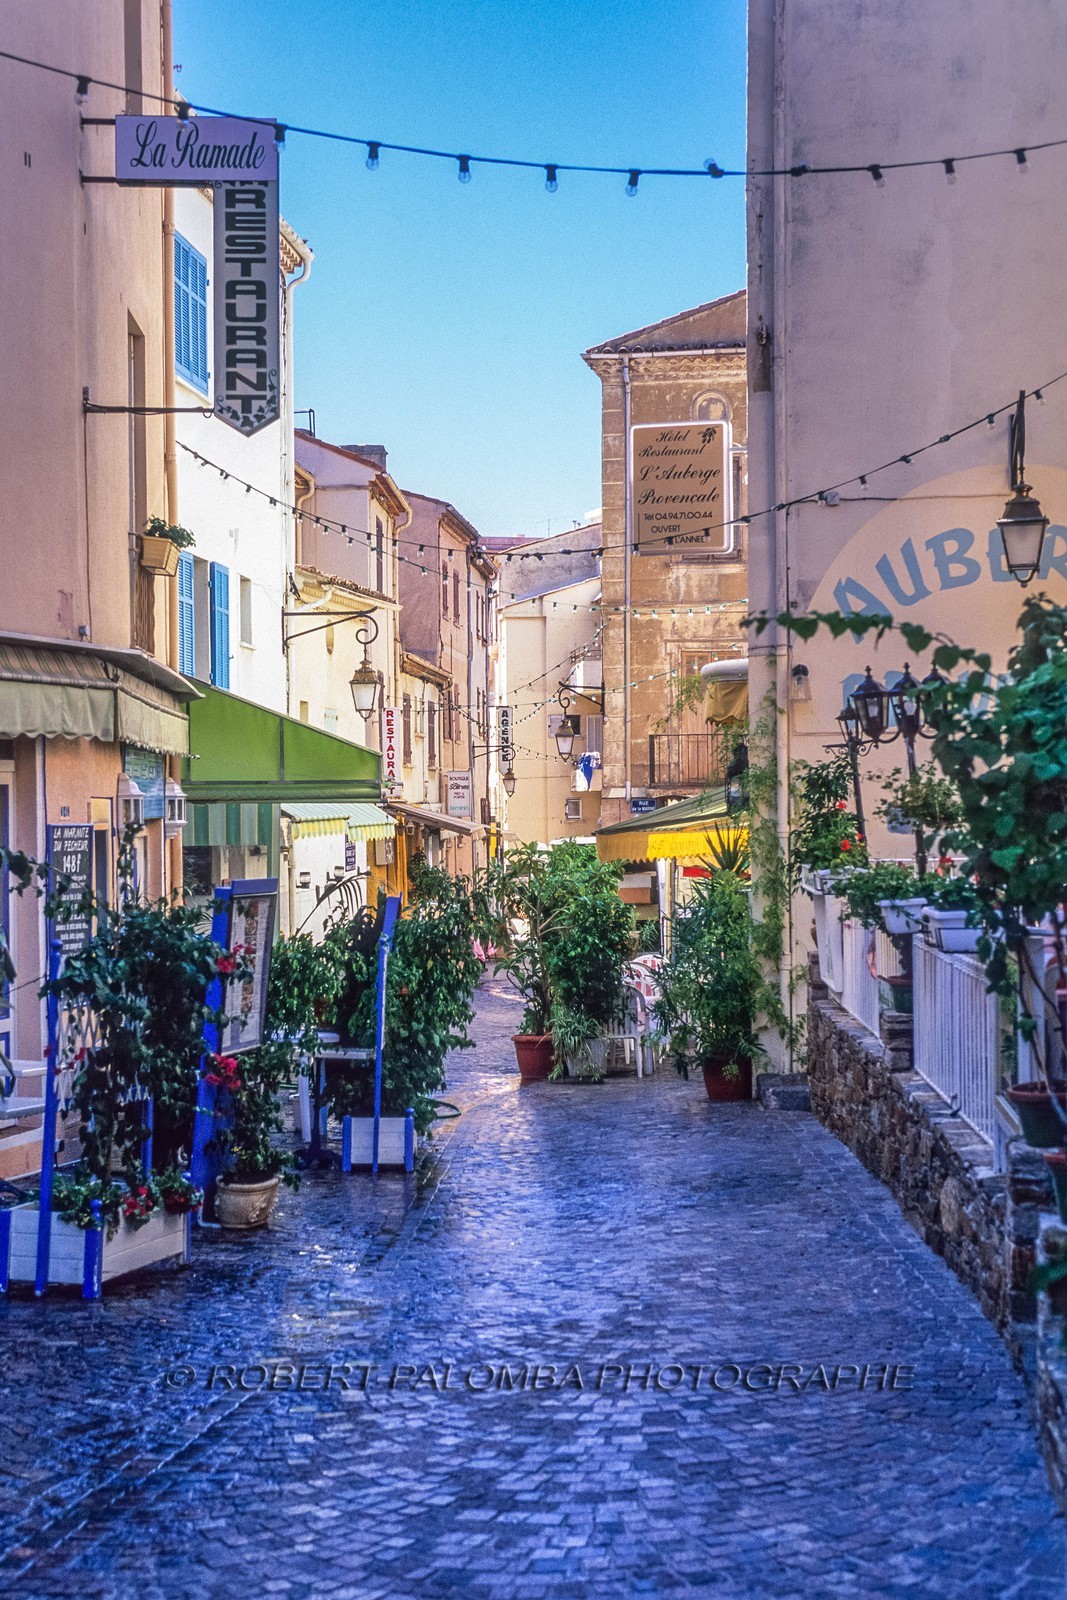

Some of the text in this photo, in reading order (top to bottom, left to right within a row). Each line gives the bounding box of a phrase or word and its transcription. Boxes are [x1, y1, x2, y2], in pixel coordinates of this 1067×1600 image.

[130, 121, 266, 170] La Ramade
[225, 189, 268, 414] RESTAURANT
[639, 444, 706, 458] Restaurant
[637, 464, 721, 486] L'Auberge
[651, 525, 680, 533] OUVERT
[386, 710, 395, 794] RESTAURAT
[53, 827, 61, 838] LA
[53, 840, 62, 851] DU
